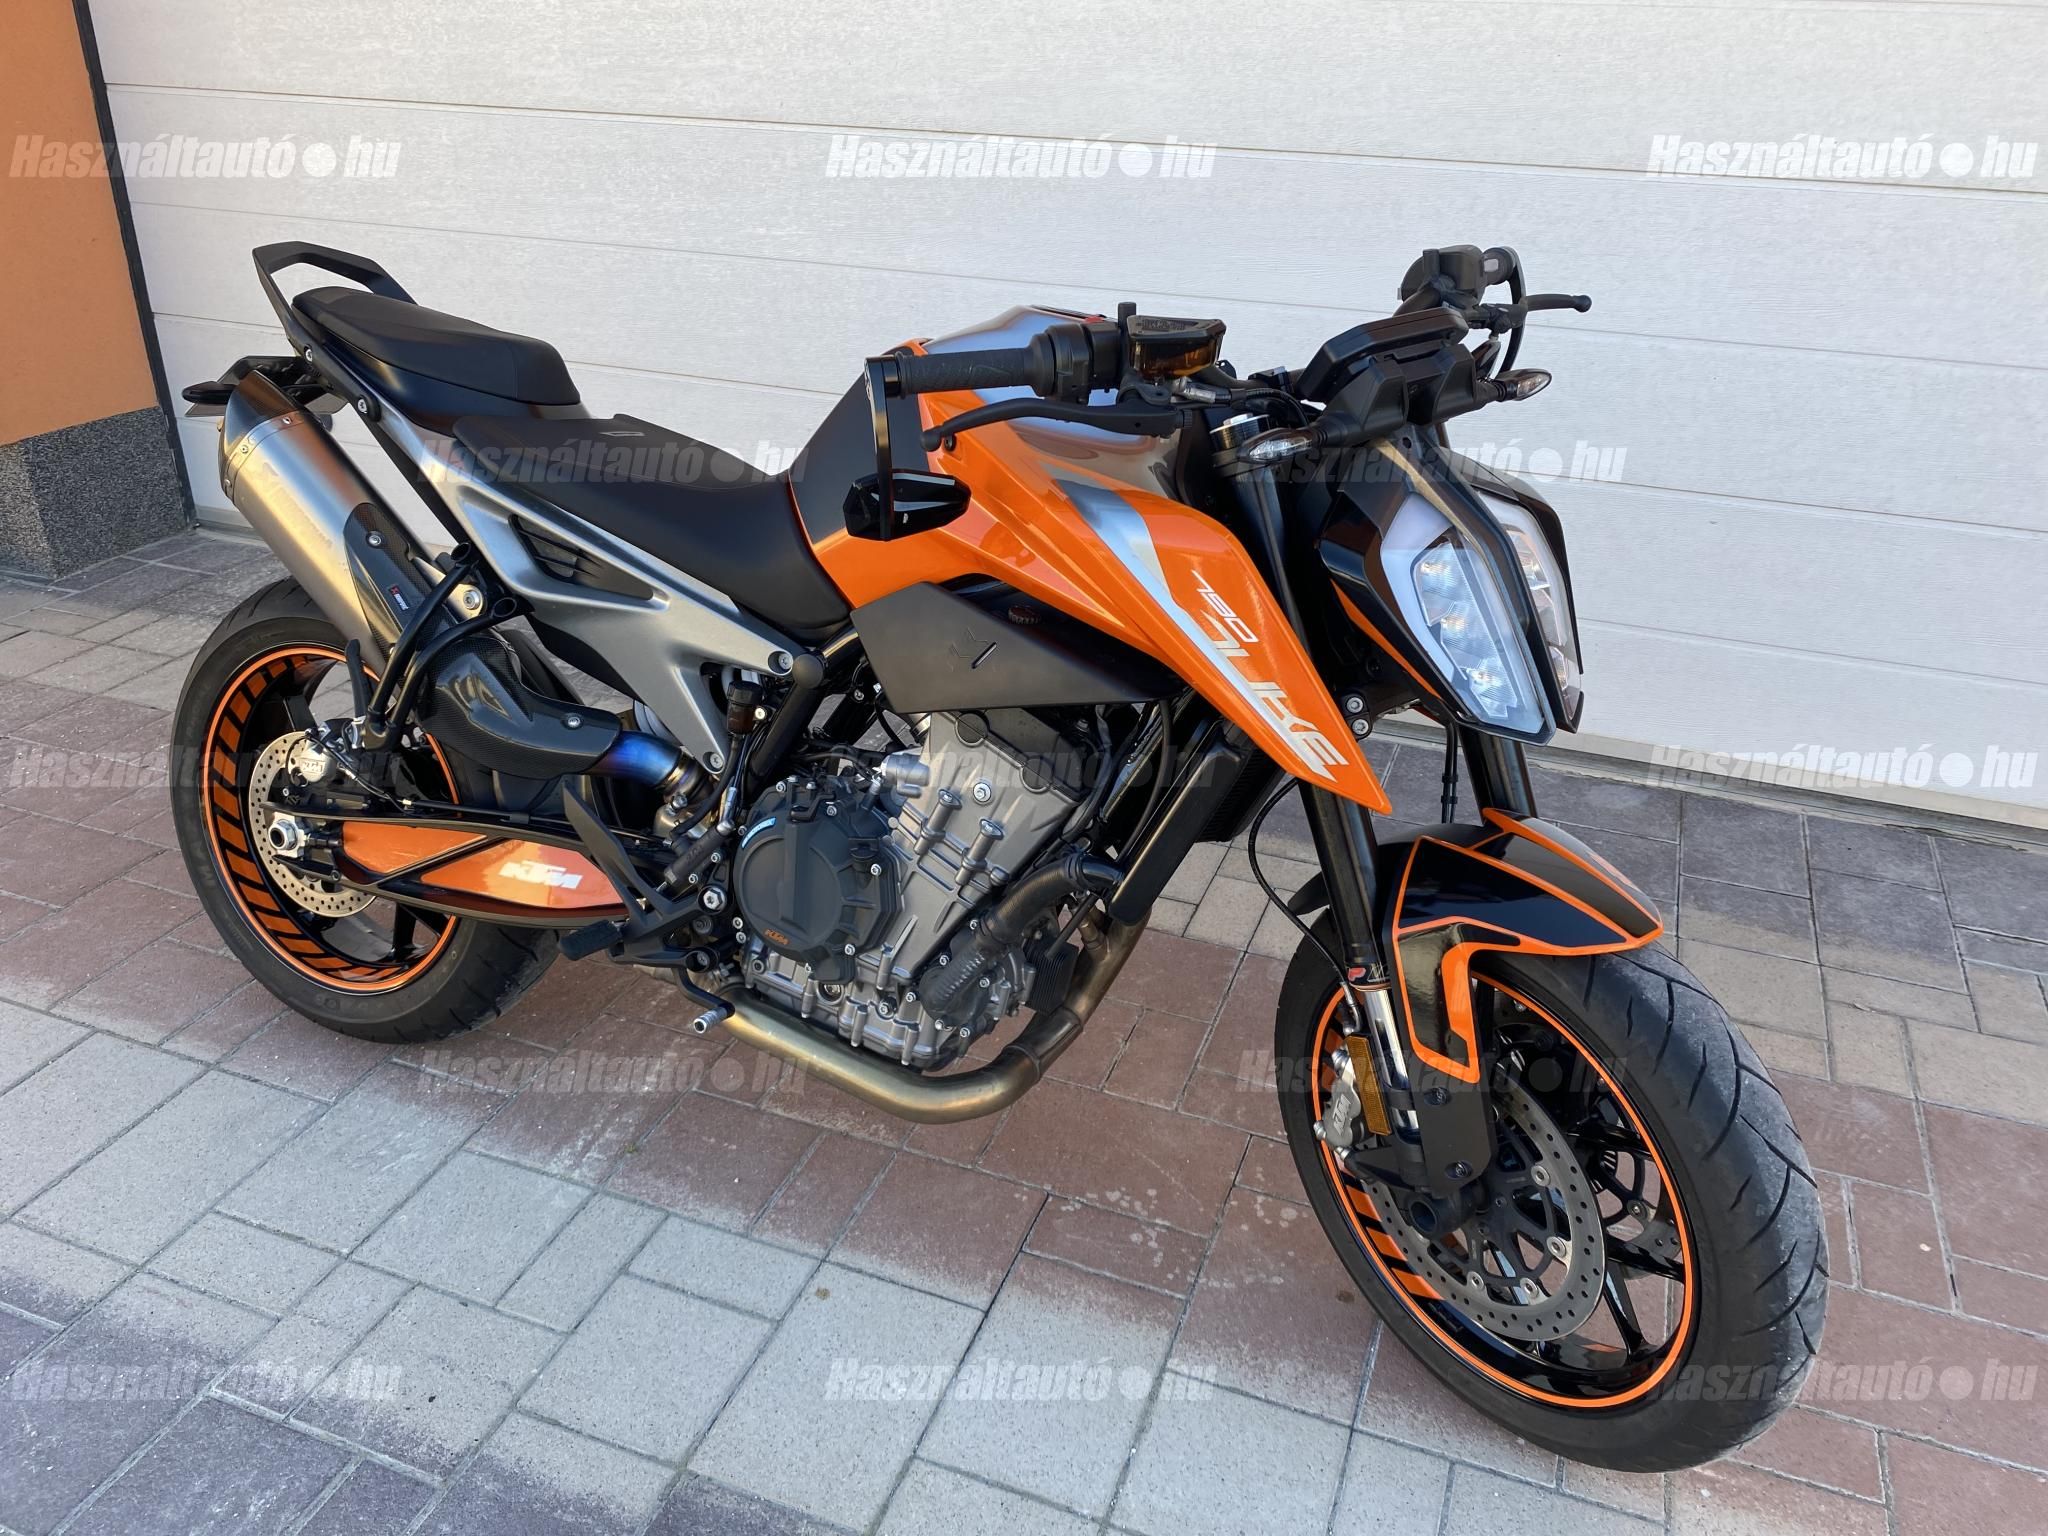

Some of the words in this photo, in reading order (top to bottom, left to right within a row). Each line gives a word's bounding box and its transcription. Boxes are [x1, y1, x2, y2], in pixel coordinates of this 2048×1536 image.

[1191, 569, 1259, 642] 790
[1200, 609, 1349, 783] DUKE
[498, 860, 584, 889] KTM
